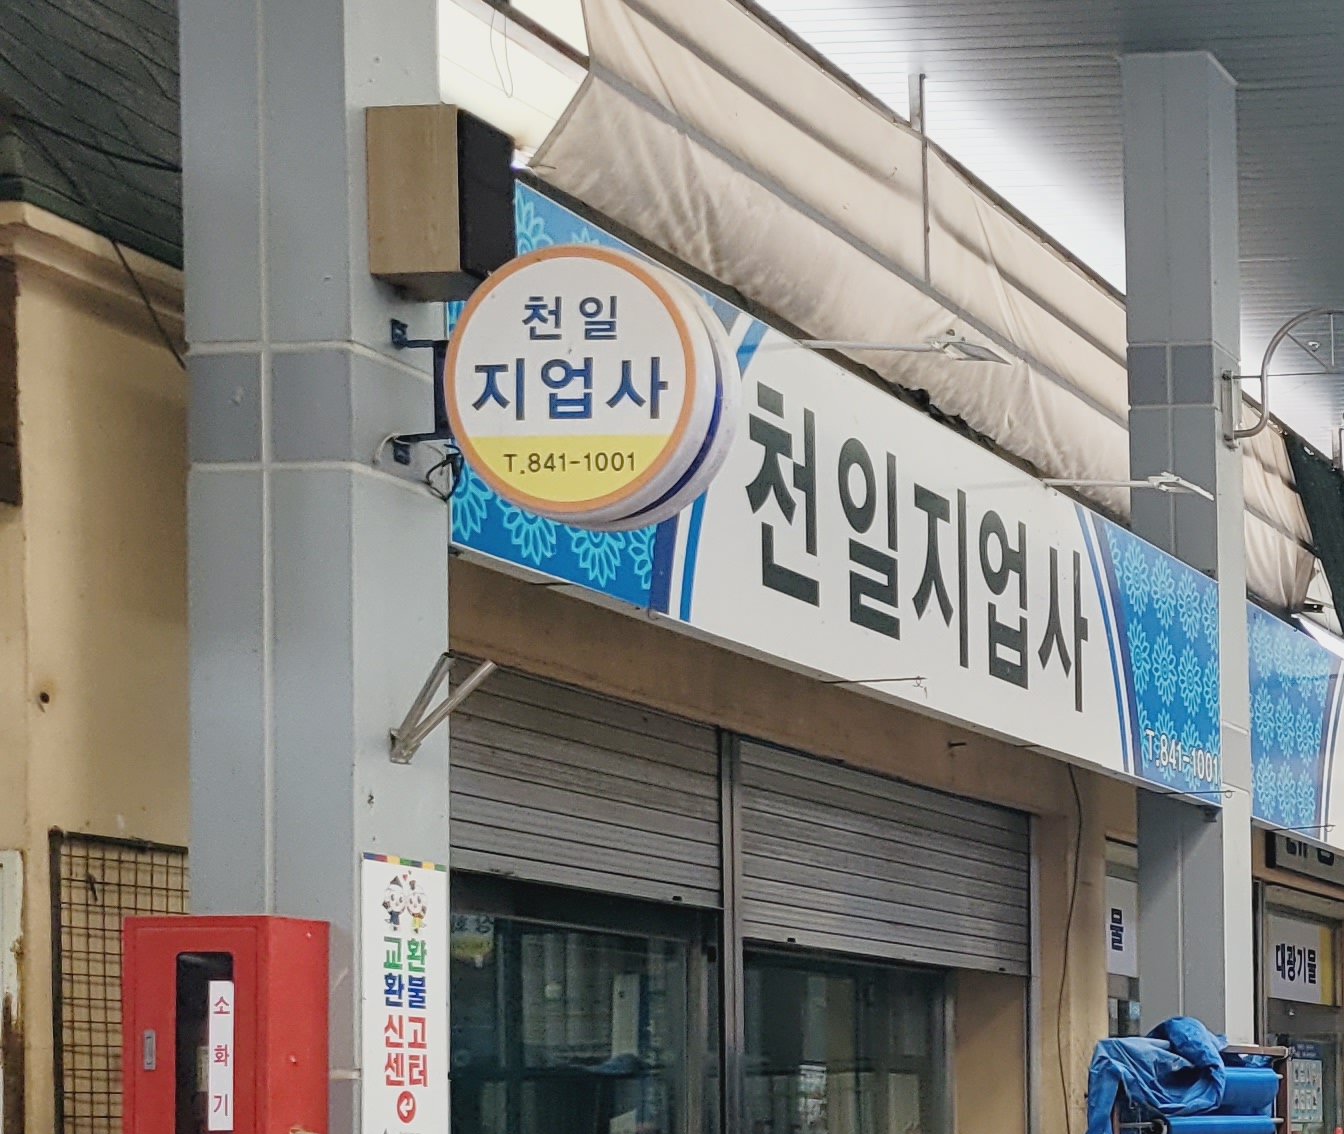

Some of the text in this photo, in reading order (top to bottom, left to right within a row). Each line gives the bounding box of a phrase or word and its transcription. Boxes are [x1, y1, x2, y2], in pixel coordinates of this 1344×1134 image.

[521, 294, 618, 341] 천일
[471, 355, 669, 421] 지업사
[503, 451, 637, 476] T.841-1001
[745, 380, 1089, 713] 천일지업사
[1144, 727, 1221, 785] T.841-1001
[1110, 907, 1124, 952] 물
[383, 936, 428, 973] 교환
[1275, 943, 1317, 985] 대광기물
[383, 973, 428, 1010] 환불
[383, 1014, 428, 1051] 신고
[213, 995, 231, 1117] 소화기
[383, 1052, 429, 1088] 센터
